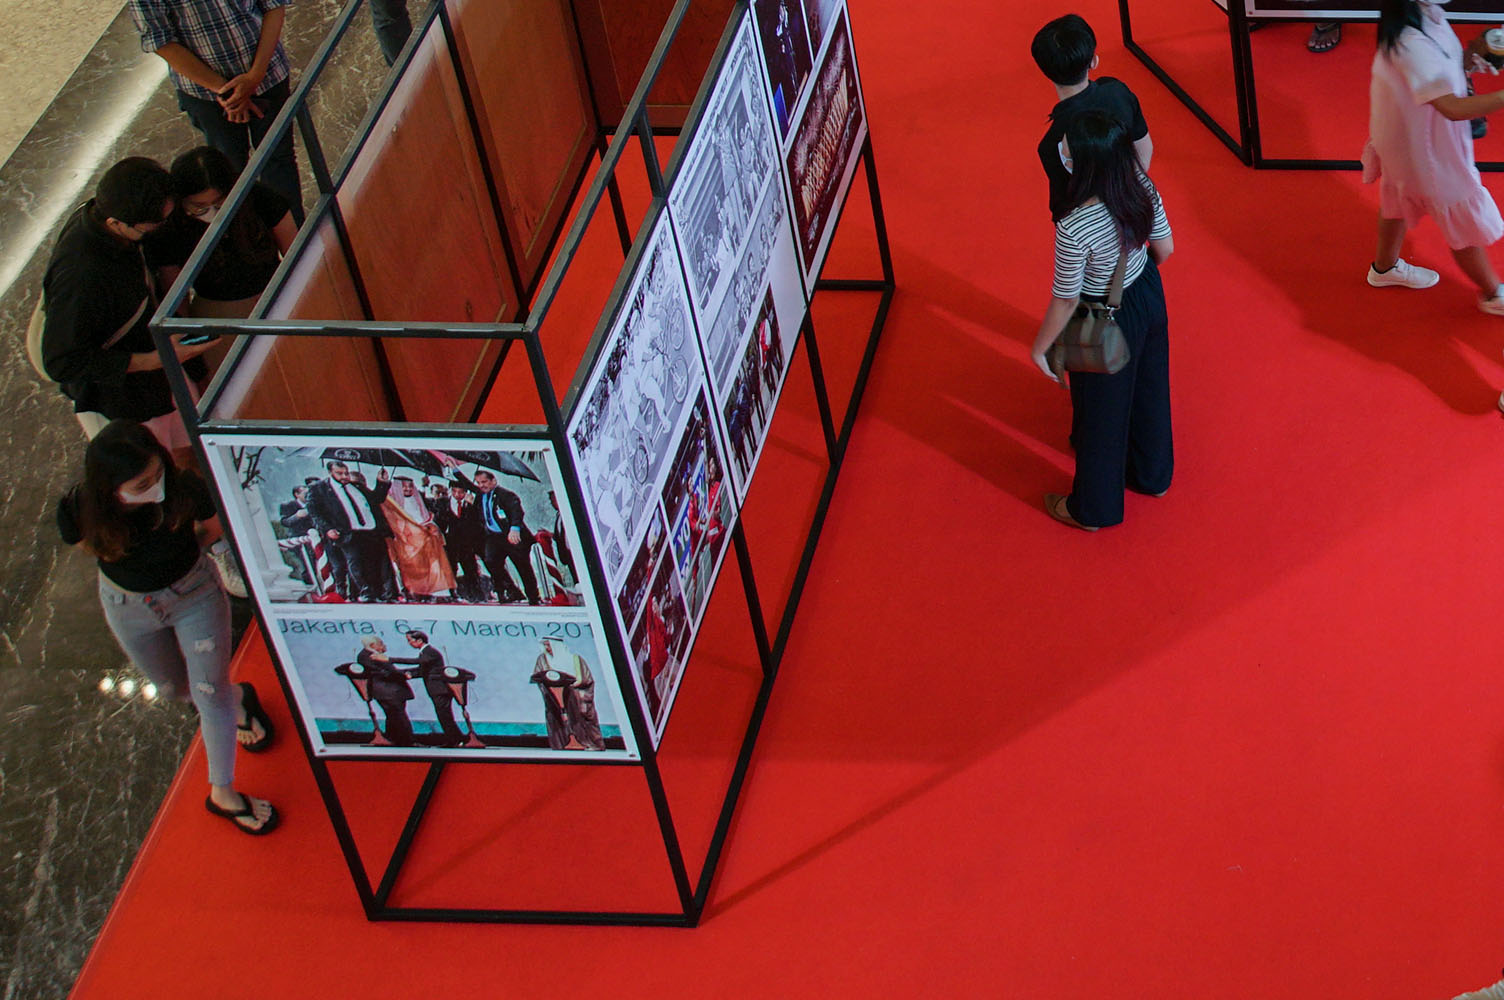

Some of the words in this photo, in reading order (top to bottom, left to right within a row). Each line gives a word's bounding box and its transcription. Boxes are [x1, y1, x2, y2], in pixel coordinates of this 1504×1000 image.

[278, 618, 384, 636] Jakarta,
[395, 618, 439, 635] 6-7
[452, 620, 537, 638] March
